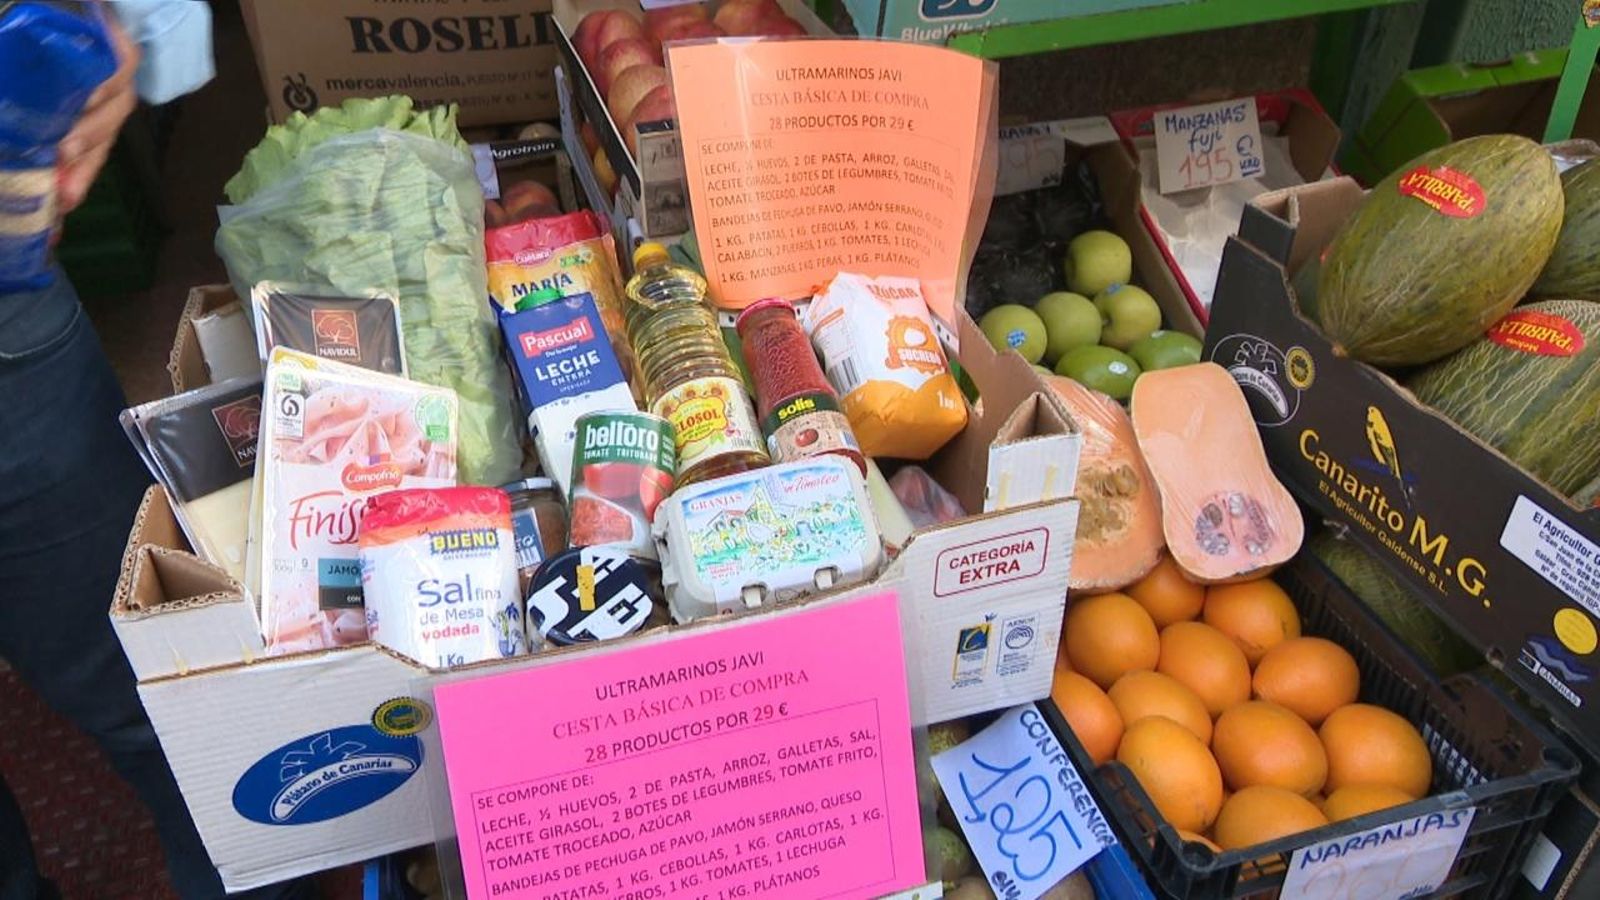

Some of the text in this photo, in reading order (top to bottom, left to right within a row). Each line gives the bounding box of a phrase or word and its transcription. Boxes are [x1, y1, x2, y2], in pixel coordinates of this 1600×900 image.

[775, 67, 902, 82] ULTRAMARINOS JAVI
[751, 87, 930, 110] CESTA BÁSICA DE COMPRA
[769, 118, 783, 130] 28
[785, 114, 859, 129] PRODUCTOS
[862, 115, 887, 129] POR
[907, 119, 915, 132] €
[804, 154, 816, 166] DE
[822, 153, 857, 165] PASTA,
[707, 178, 743, 192] ACEITE
[821, 170, 833, 180] DE
[838, 168, 900, 180] LEGUMBRES,
[511, 272, 573, 297] MARÍA
[525, 322, 588, 351] Pascual
[535, 350, 601, 381] LECHE
[778, 398, 816, 419] solis
[690, 492, 742, 512] GRANJAS
[1300, 429, 1491, 608] Canarito M.G.
[433, 531, 497, 550] BUENO
[1318, 480, 1449, 595] El Agricultor Galdense S.L.
[1532, 511, 1542, 525] El
[1543, 519, 1593, 559] Agricultor
[949, 539, 1035, 569] CATEGORÍA
[959, 559, 1021, 585] EXTRA
[417, 573, 501, 608] Sal fina
[420, 607, 484, 626] de Mesa
[422, 622, 481, 642] yodada
[595, 651, 765, 701] ULTRAMARINOS JAVI
[552, 669, 810, 740] CESTA BÁSICA DE COMPRA
[584, 702, 789, 764] 28 PRODUCTOS POR 29 €
[281, 758, 393, 806] Plátano de Canarias
[477, 774, 595, 810] SE COMPONE DE:
[481, 813, 531, 834] LECHE,
[559, 791, 622, 817] HUEVOS,
[628, 786, 637, 800] 2
[645, 780, 663, 795] DE
[670, 767, 716, 788] PASTA,
[722, 752, 771, 773] ARROZ,
[777, 735, 844, 761] GALLETAS,
[849, 728, 877, 743] SAL,
[1019, 709, 1117, 848] CONFERENCIA
[485, 746, 878, 853] ACEITE GIRASOL, 2 BOTES DE LEGUMBRES, TOMATE FRITO,
[487, 809, 692, 872] TOMATE TROCEADO, AZÚCAR
[491, 789, 863, 896] BANDEJAS DE PECHUGA DE PAVO, JAMÓN SERRANO, QUESO
[615, 877, 624, 889] 1
[630, 870, 653, 886] KG.
[659, 848, 729, 877] CEBOLLAS,
[735, 843, 742, 855] 1
[747, 836, 770, 852] KG.
[775, 817, 844, 845] CARLOTAS,
[850, 814, 857, 826] 1
[863, 807, 884, 823] KG.
[1300, 809, 1468, 869] NARANJAS
[670, 835, 847, 892] 1 KG. TOMATES, 1 LECHUGA
[729, 884, 750, 897] KG.
[753, 864, 820, 892] PLÁTANOS
